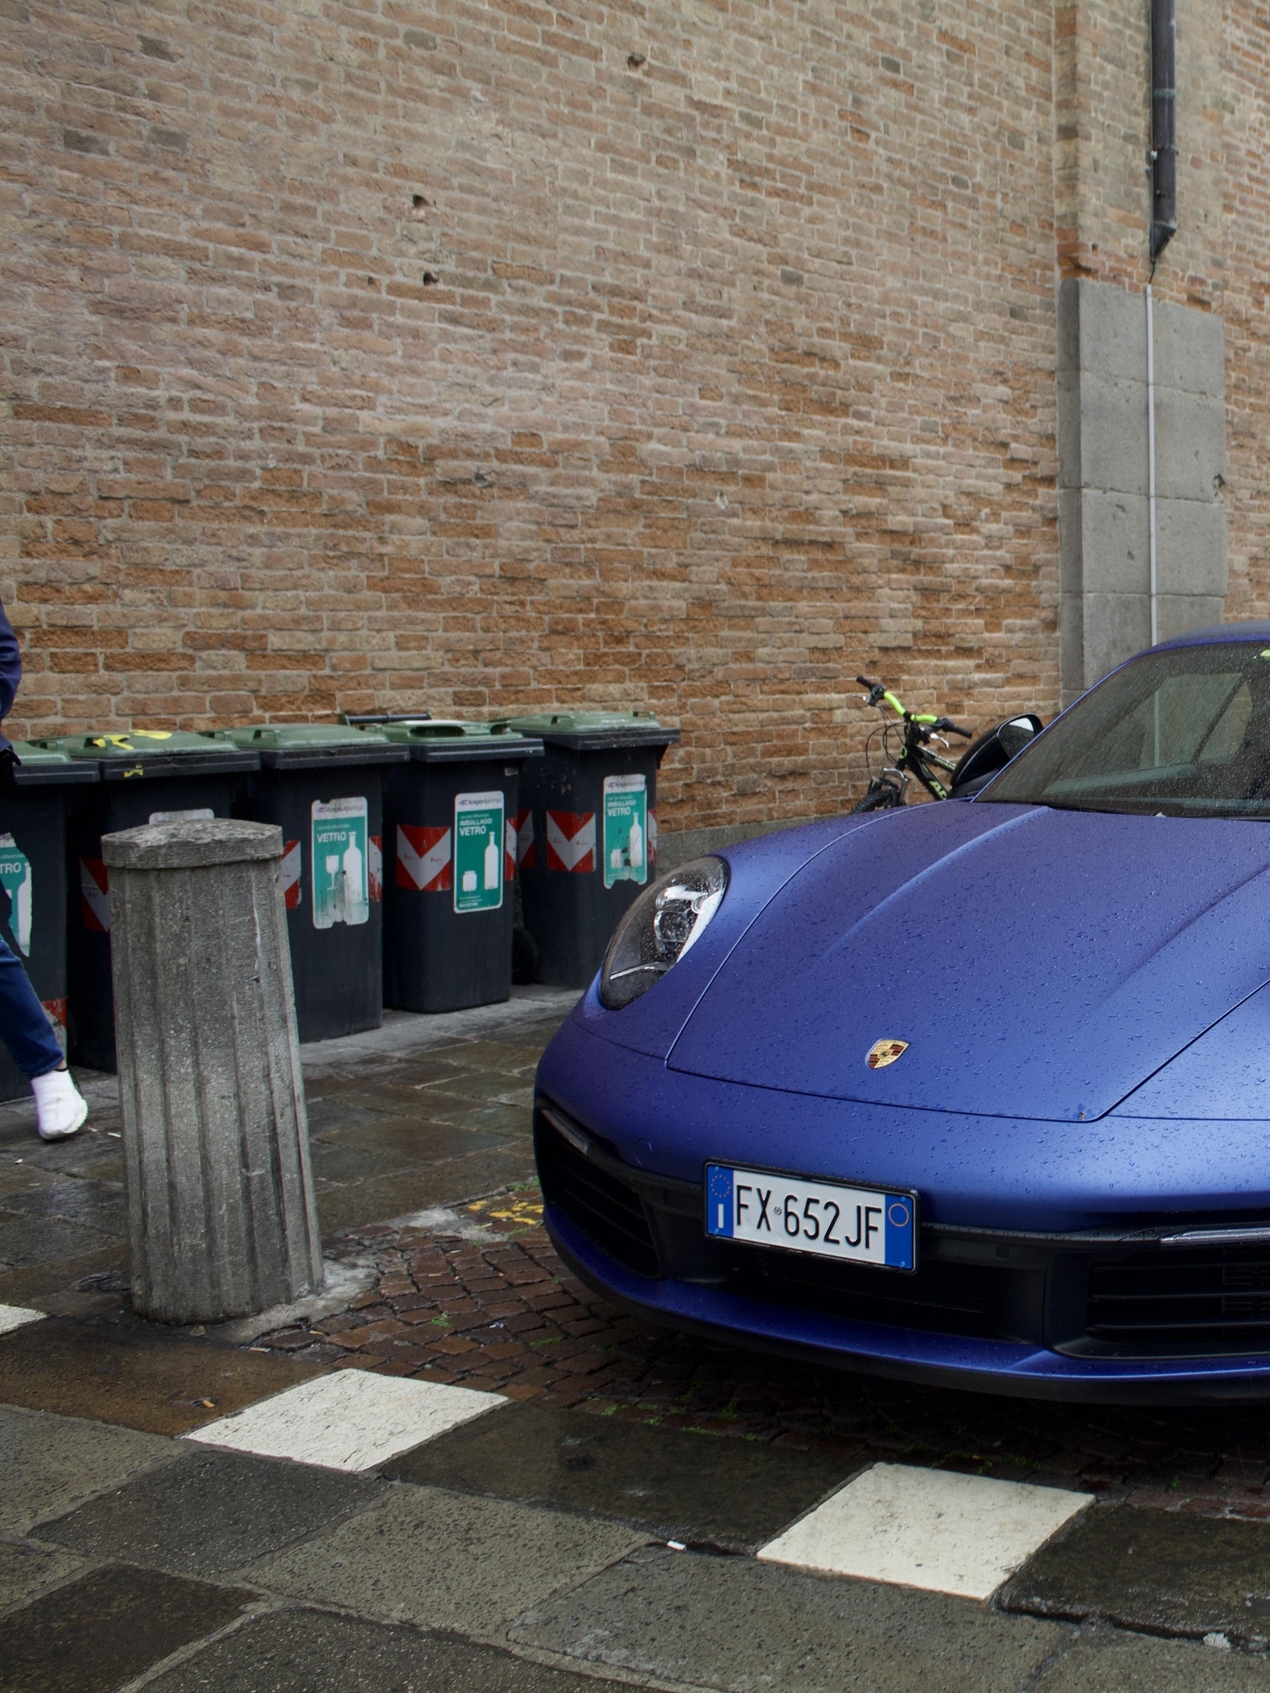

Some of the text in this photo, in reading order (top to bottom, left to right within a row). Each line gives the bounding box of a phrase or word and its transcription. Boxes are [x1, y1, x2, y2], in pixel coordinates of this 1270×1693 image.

[607, 806, 631, 817] VETRO
[460, 825, 487, 836] VETRO
[317, 831, 347, 843] VETRO
[0, 862, 21, 874] TRO
[737, 1185, 882, 1249] FX 652JF
